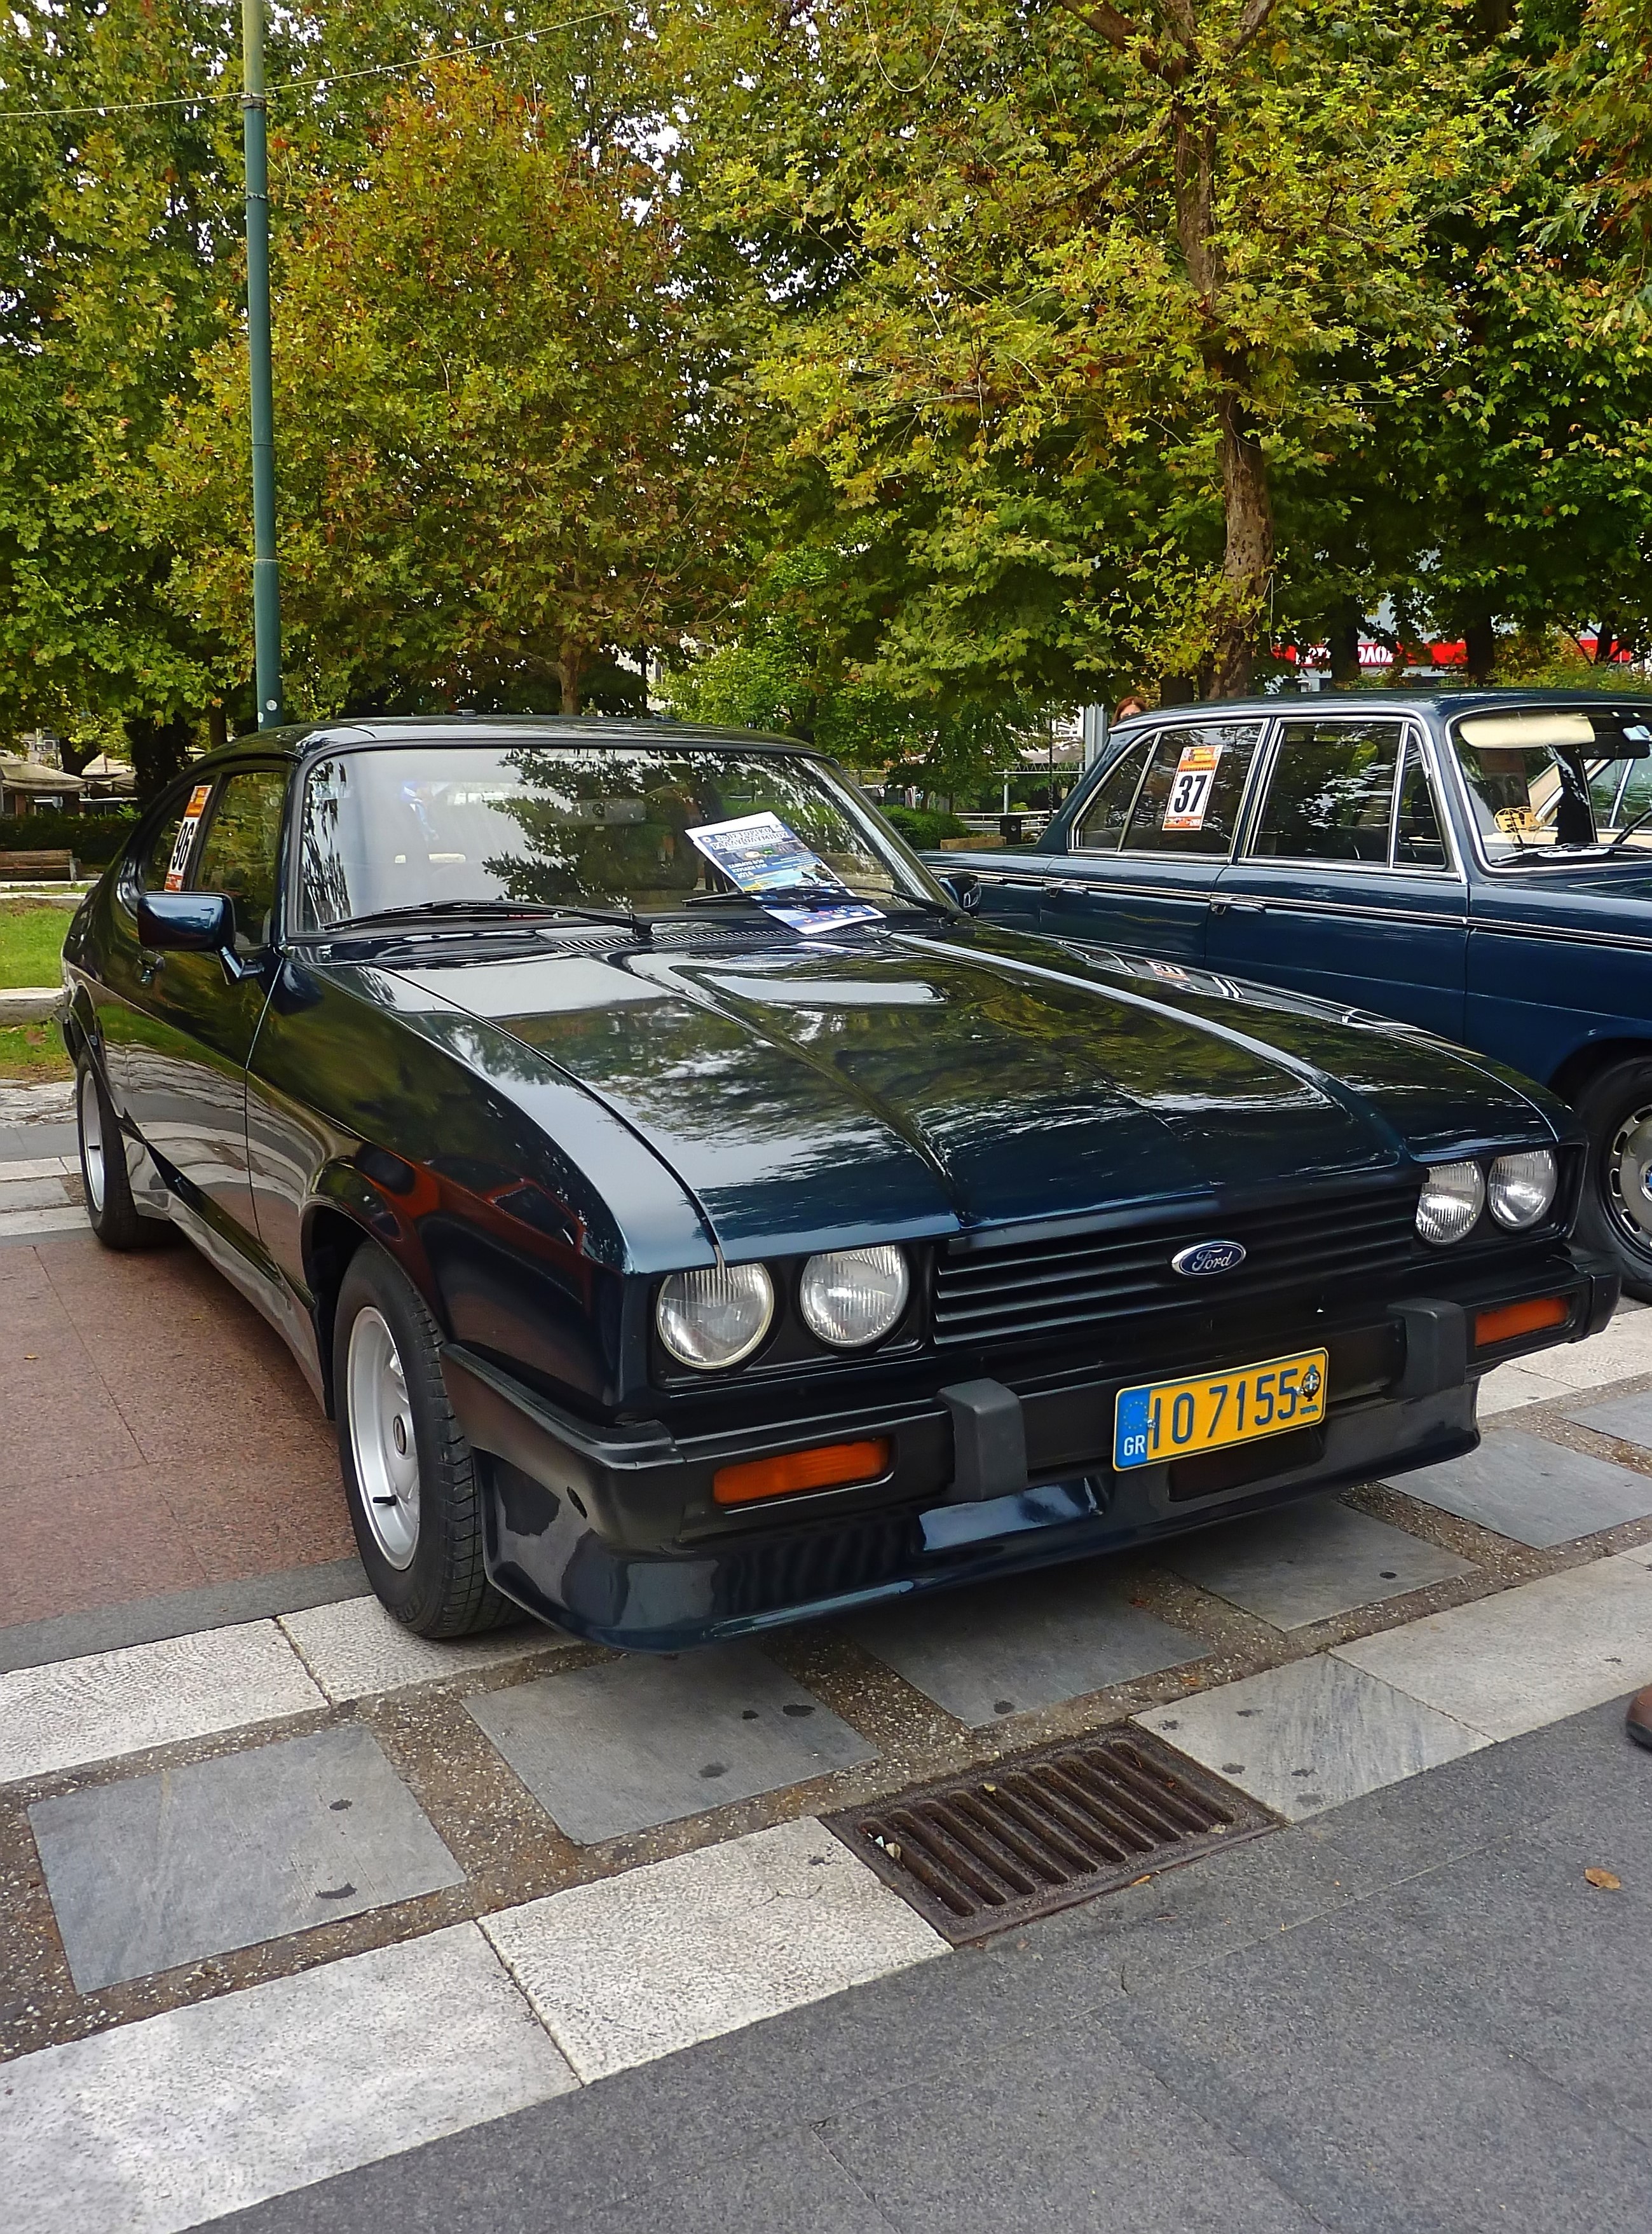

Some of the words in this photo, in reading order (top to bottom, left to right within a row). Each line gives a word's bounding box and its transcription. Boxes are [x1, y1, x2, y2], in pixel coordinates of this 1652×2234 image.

[1174, 775, 1208, 813] 37
[712, 840, 742, 848] ΡΑΛΛΥ
[744, 832, 787, 843] ΟΛΥΜΠΟΥ
[728, 828, 770, 838] ΙΣΤΟΡΙΚΟ
[172, 821, 195, 871] 96
[1192, 1248, 1234, 1271] Ford
[1207, 1368, 1298, 1438] 7155
[1123, 1434, 1145, 1457] GR
